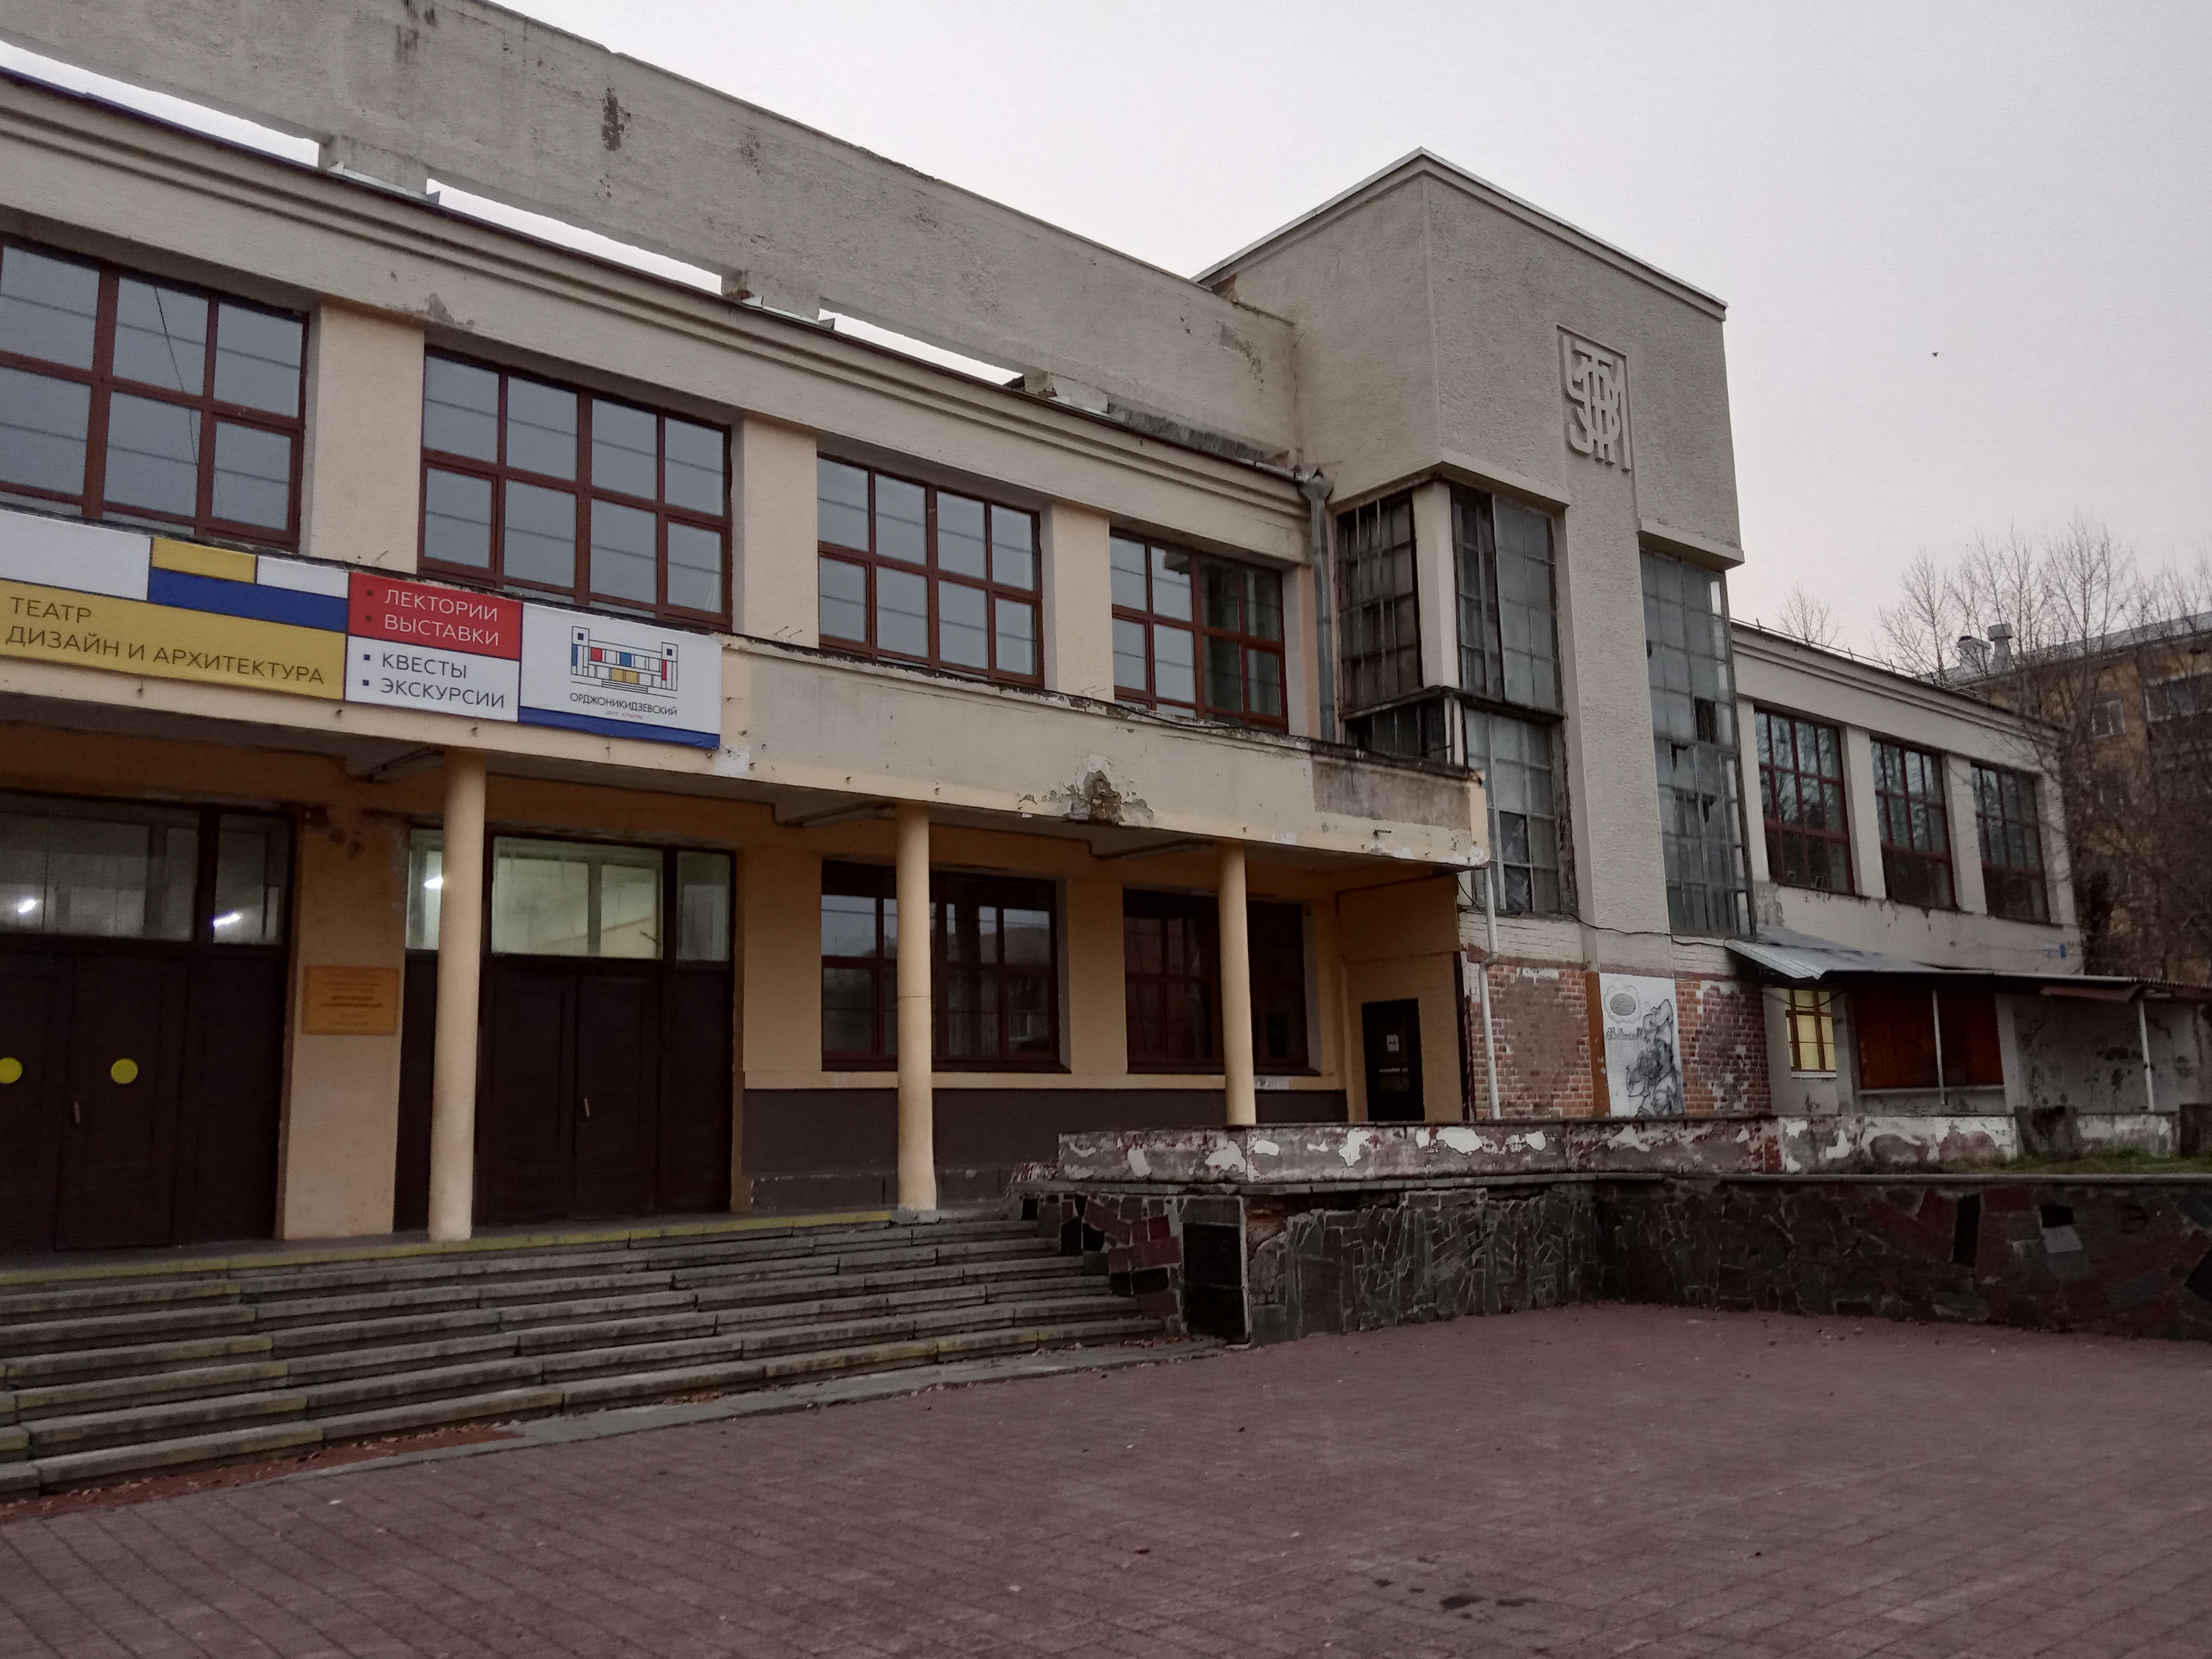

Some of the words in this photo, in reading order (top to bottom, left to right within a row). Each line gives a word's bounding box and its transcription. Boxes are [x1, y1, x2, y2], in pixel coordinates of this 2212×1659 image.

[10, 597, 91, 624] ТЕАТР
[384, 589, 498, 622] ЛЕКТОРИИ
[384, 614, 499, 646] ВЫСТАВКИ
[5, 625, 119, 658] ДИЗАЙН
[128, 642, 145, 660] И
[153, 647, 324, 685] АРХИТЕКТУРА
[382, 652, 466, 679] КВЕСТЫ
[381, 678, 505, 709] ЭКСКУРСИИ
[569, 692, 677, 717] ОРДЖОНИКИДЗЕВСКИЙ
